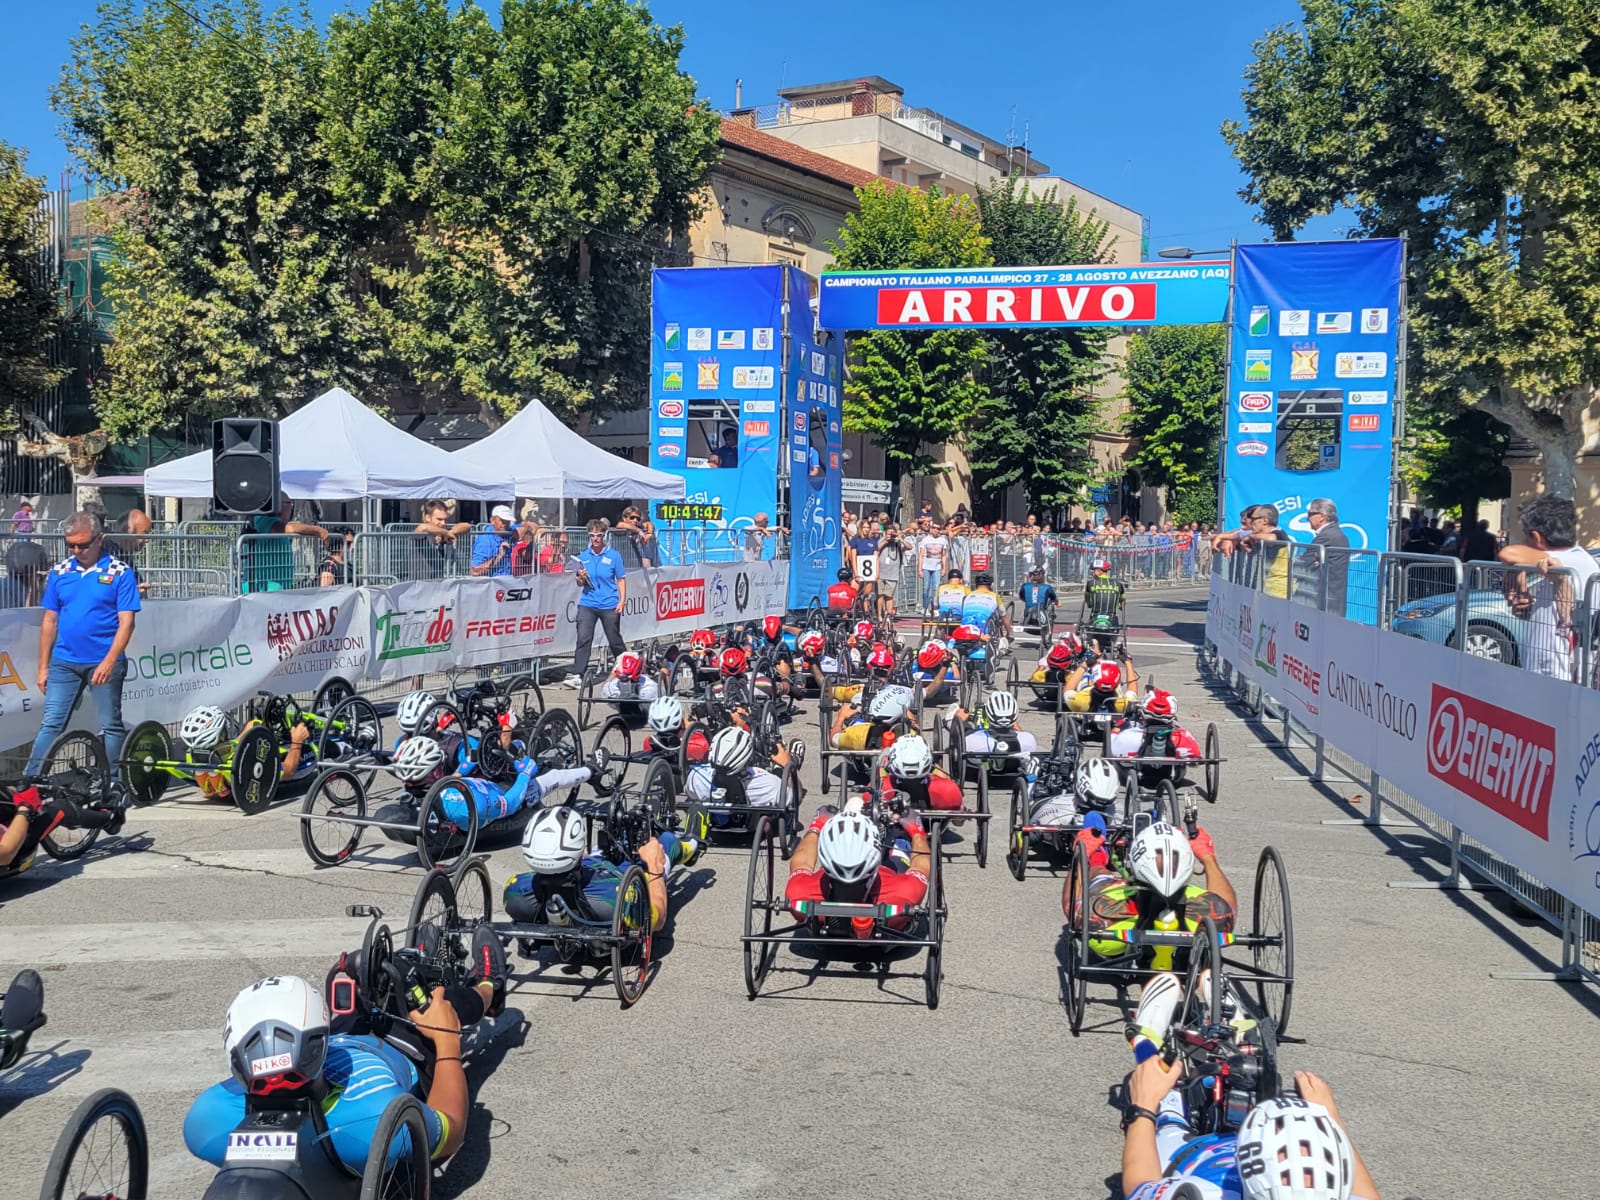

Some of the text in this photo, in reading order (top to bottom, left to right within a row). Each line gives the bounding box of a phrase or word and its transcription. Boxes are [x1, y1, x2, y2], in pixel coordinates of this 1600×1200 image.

[825, 276, 897, 287] CAMPIONATO
[899, 275, 952, 286] ITALIANO
[954, 273, 1031, 284] PARALIMPICO
[1033, 273, 1048, 283] 27
[1058, 273, 1072, 282] 28
[1075, 271, 1127, 281] AGOSTO
[1130, 269, 1199, 280] AVEZZANO
[1201, 268, 1230, 280] (AQ)
[898, 286, 1135, 322] ARRIVO
[1246, 397, 1265, 407] PATA
[661, 505, 721, 519] 10:41:47
[1276, 495, 1303, 515] ESI
[862, 559, 873, 577] 8
[671, 585, 705, 612] ENERVIT
[292, 606, 339, 641] ITAS
[466, 618, 517, 639] FREE
[304, 658, 332, 673] CHIETI
[334, 654, 366, 669] SCALO
[158, 677, 221, 697] odontoiatrico
[1327, 661, 1417, 741] CANTINA TOLLO
[1457, 717, 1554, 815] ENERVIT
[1569, 803, 1577, 850] Team
[1237, 1141, 1265, 1179] 68
